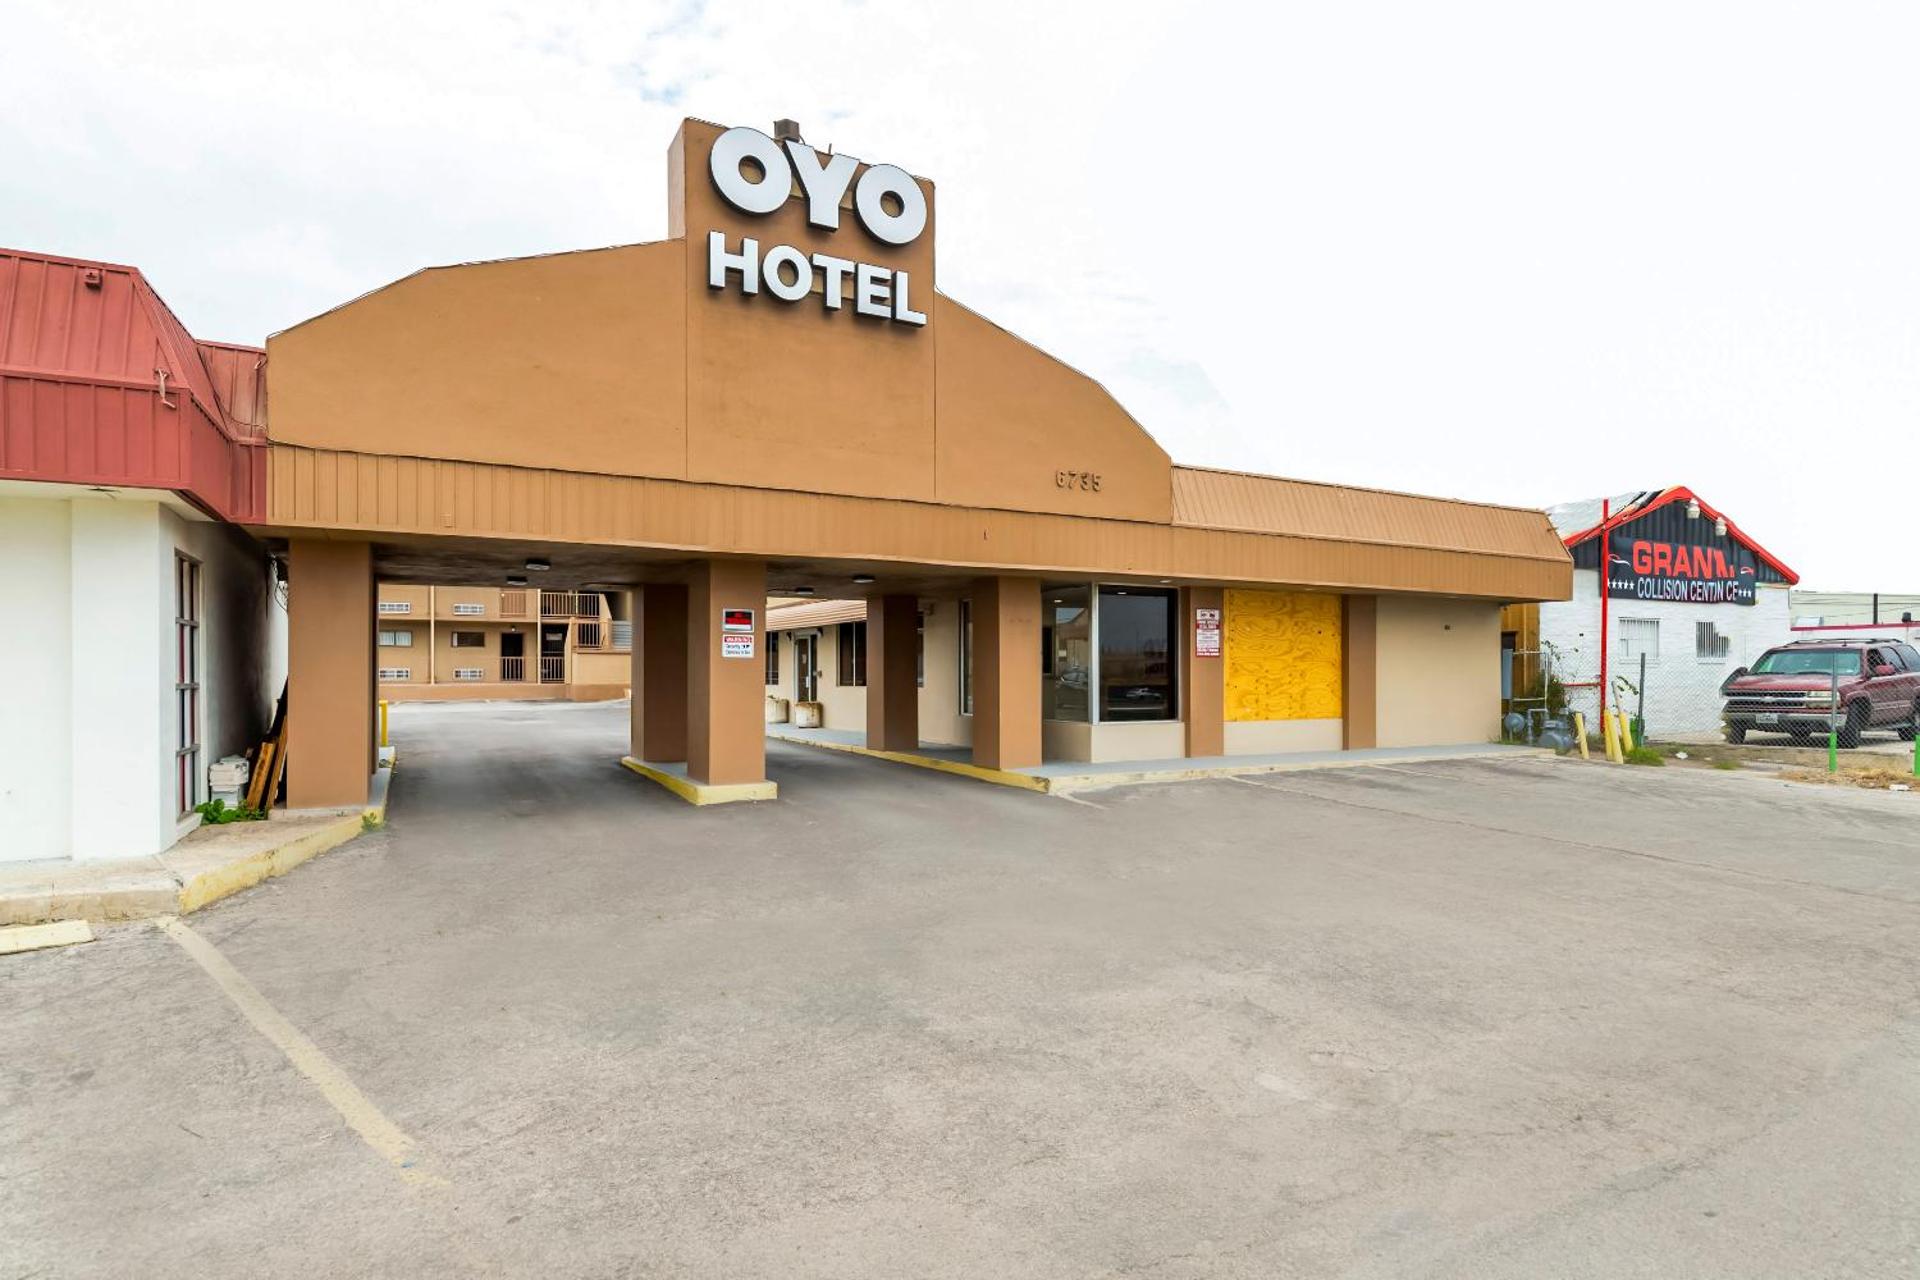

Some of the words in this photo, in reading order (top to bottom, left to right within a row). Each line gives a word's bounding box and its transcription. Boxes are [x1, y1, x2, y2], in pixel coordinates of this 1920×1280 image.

[709, 126, 927, 245] OYO
[708, 231, 927, 326] HOTEL
[1055, 470, 1103, 493] 6735
[1637, 577, 1688, 601] COLLISION
